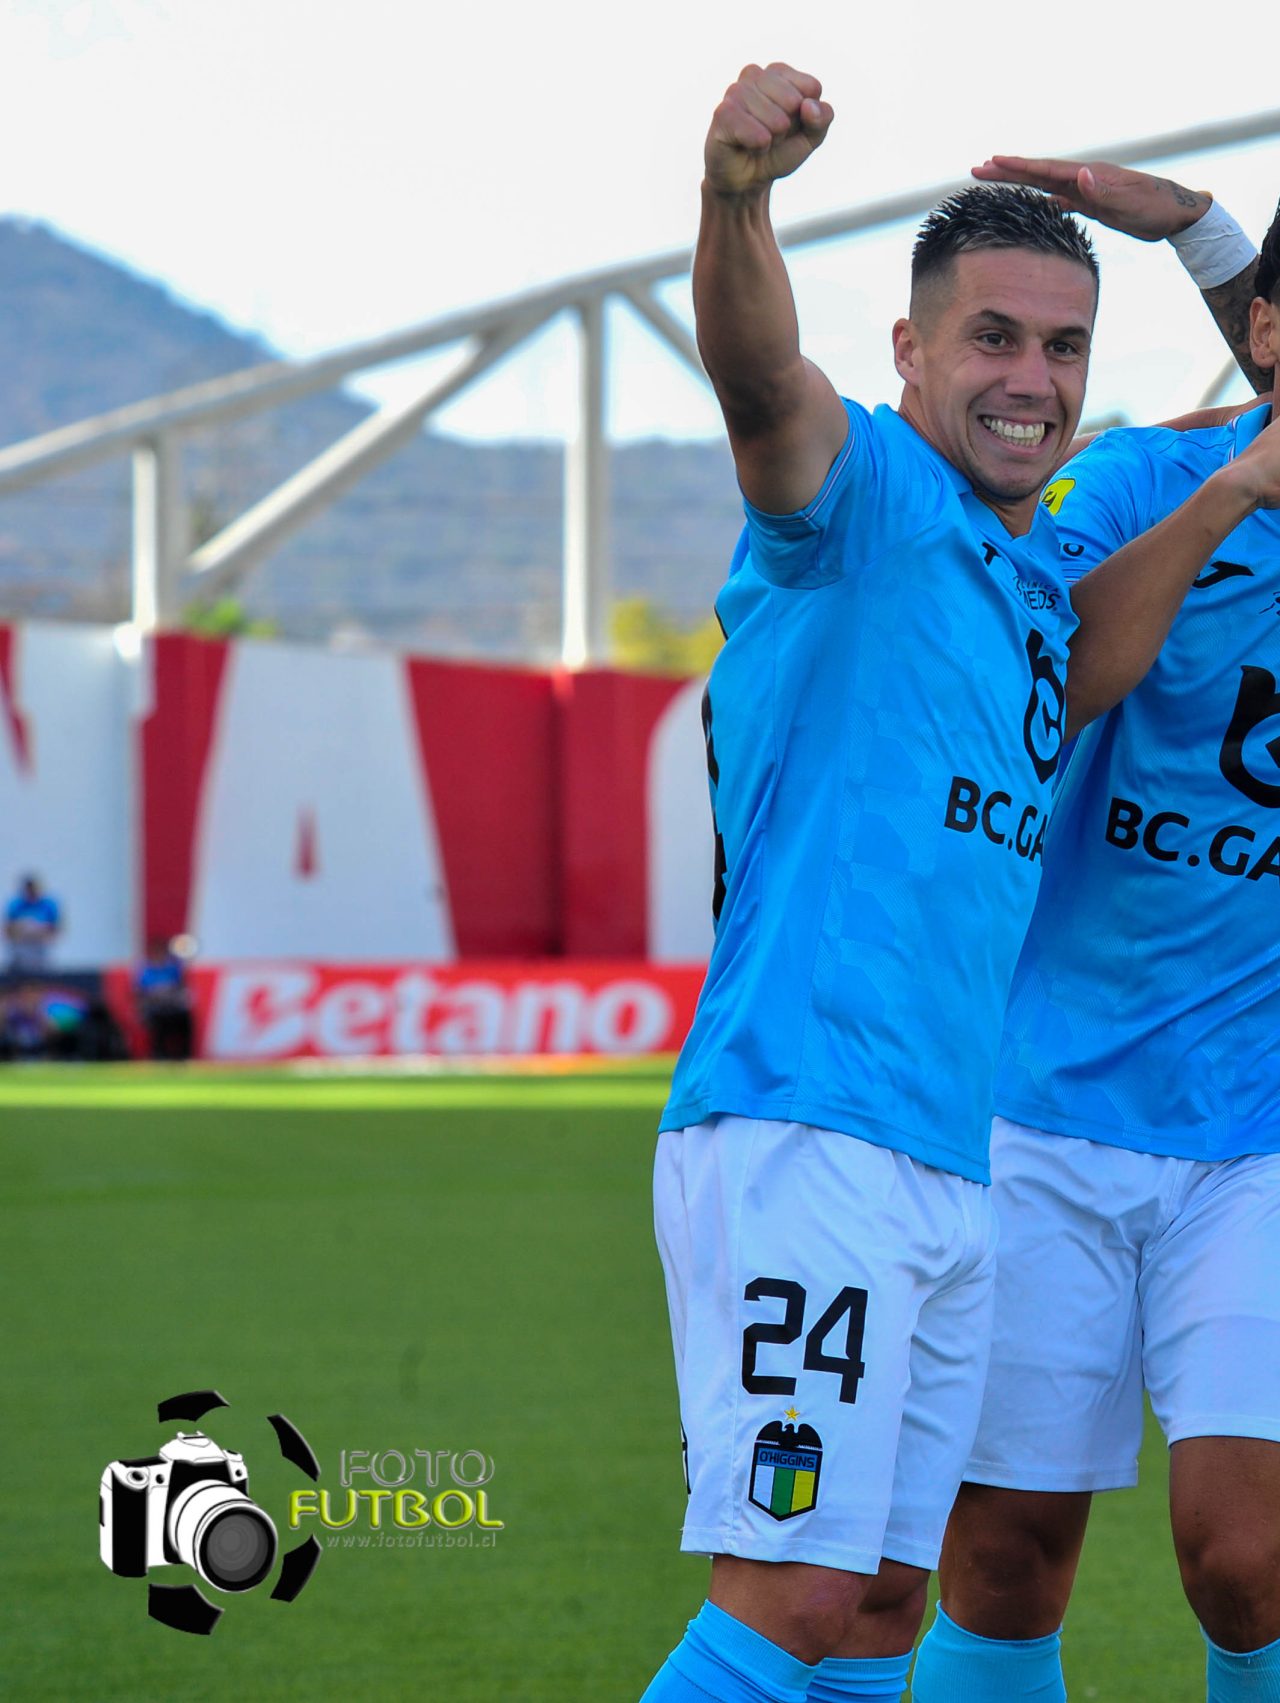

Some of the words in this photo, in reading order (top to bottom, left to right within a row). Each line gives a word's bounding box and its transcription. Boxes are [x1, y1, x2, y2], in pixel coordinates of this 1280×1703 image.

[944, 775, 1048, 867] BC.GA
[205, 968, 674, 1057] Betano
[741, 1276, 869, 1405] 24
[758, 1450, 815, 1469] O'HIGGINS
